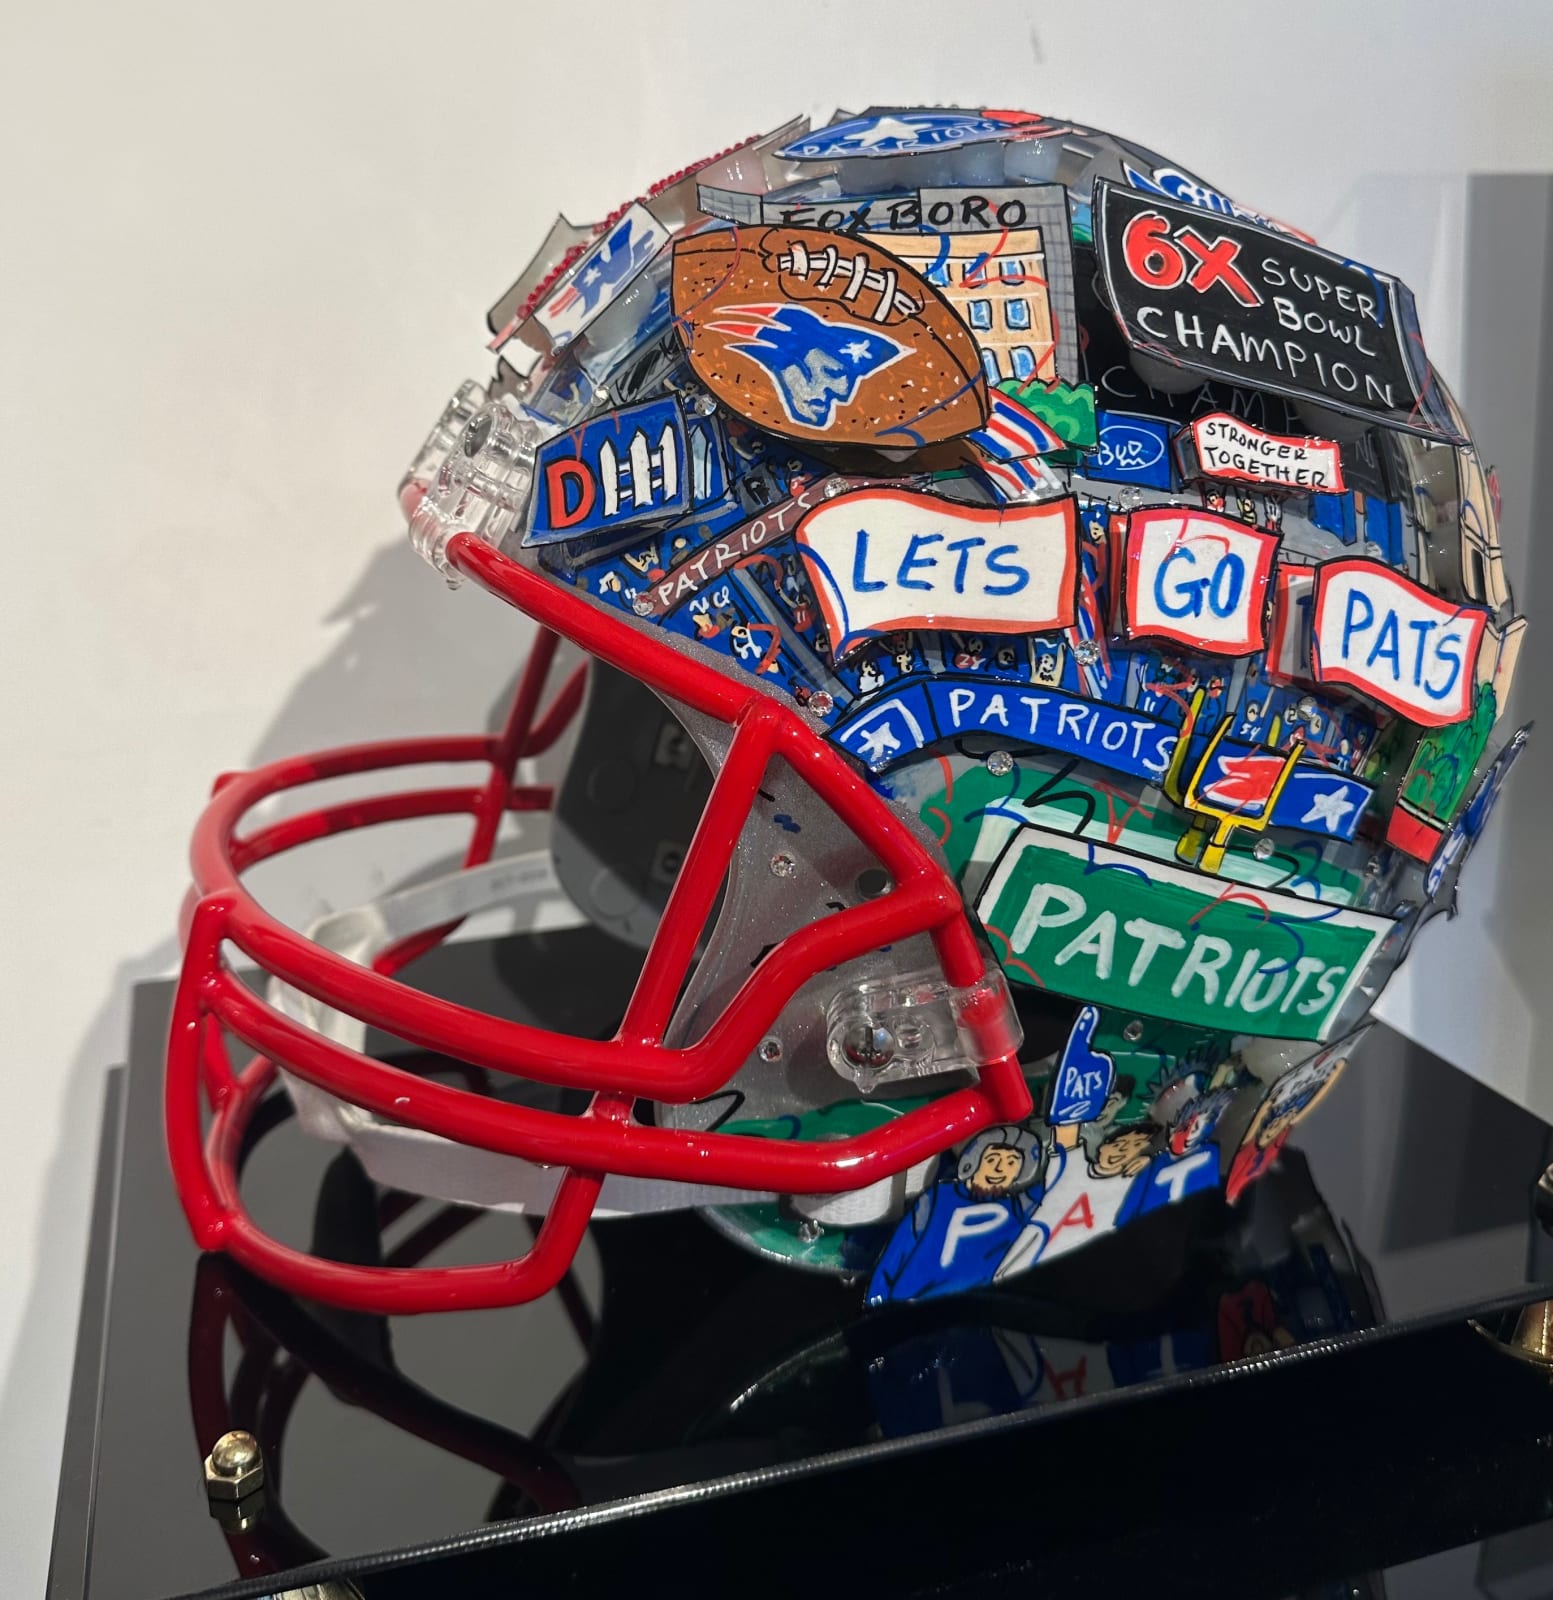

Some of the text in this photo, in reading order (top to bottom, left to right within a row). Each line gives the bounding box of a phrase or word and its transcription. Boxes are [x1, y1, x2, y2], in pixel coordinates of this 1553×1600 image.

[803, 122, 997, 156] PATRIOTS
[1122, 210, 1380, 323] 6X SUPER
[1137, 305, 1394, 409] CHAMPION
[1272, 297, 1377, 356] BOWL
[1204, 446, 1329, 489] TOGETHER
[1205, 422, 1308, 461] STRONGER
[657, 491, 812, 607] PATRIOTS
[852, 528, 1461, 700] LETS GO PATS
[949, 687, 1178, 772] PATRIOTS
[1010, 882, 1346, 1016] PATRIOTS
[1063, 1066, 1103, 1099] PATS
[940, 1152, 1216, 1267] P A T
